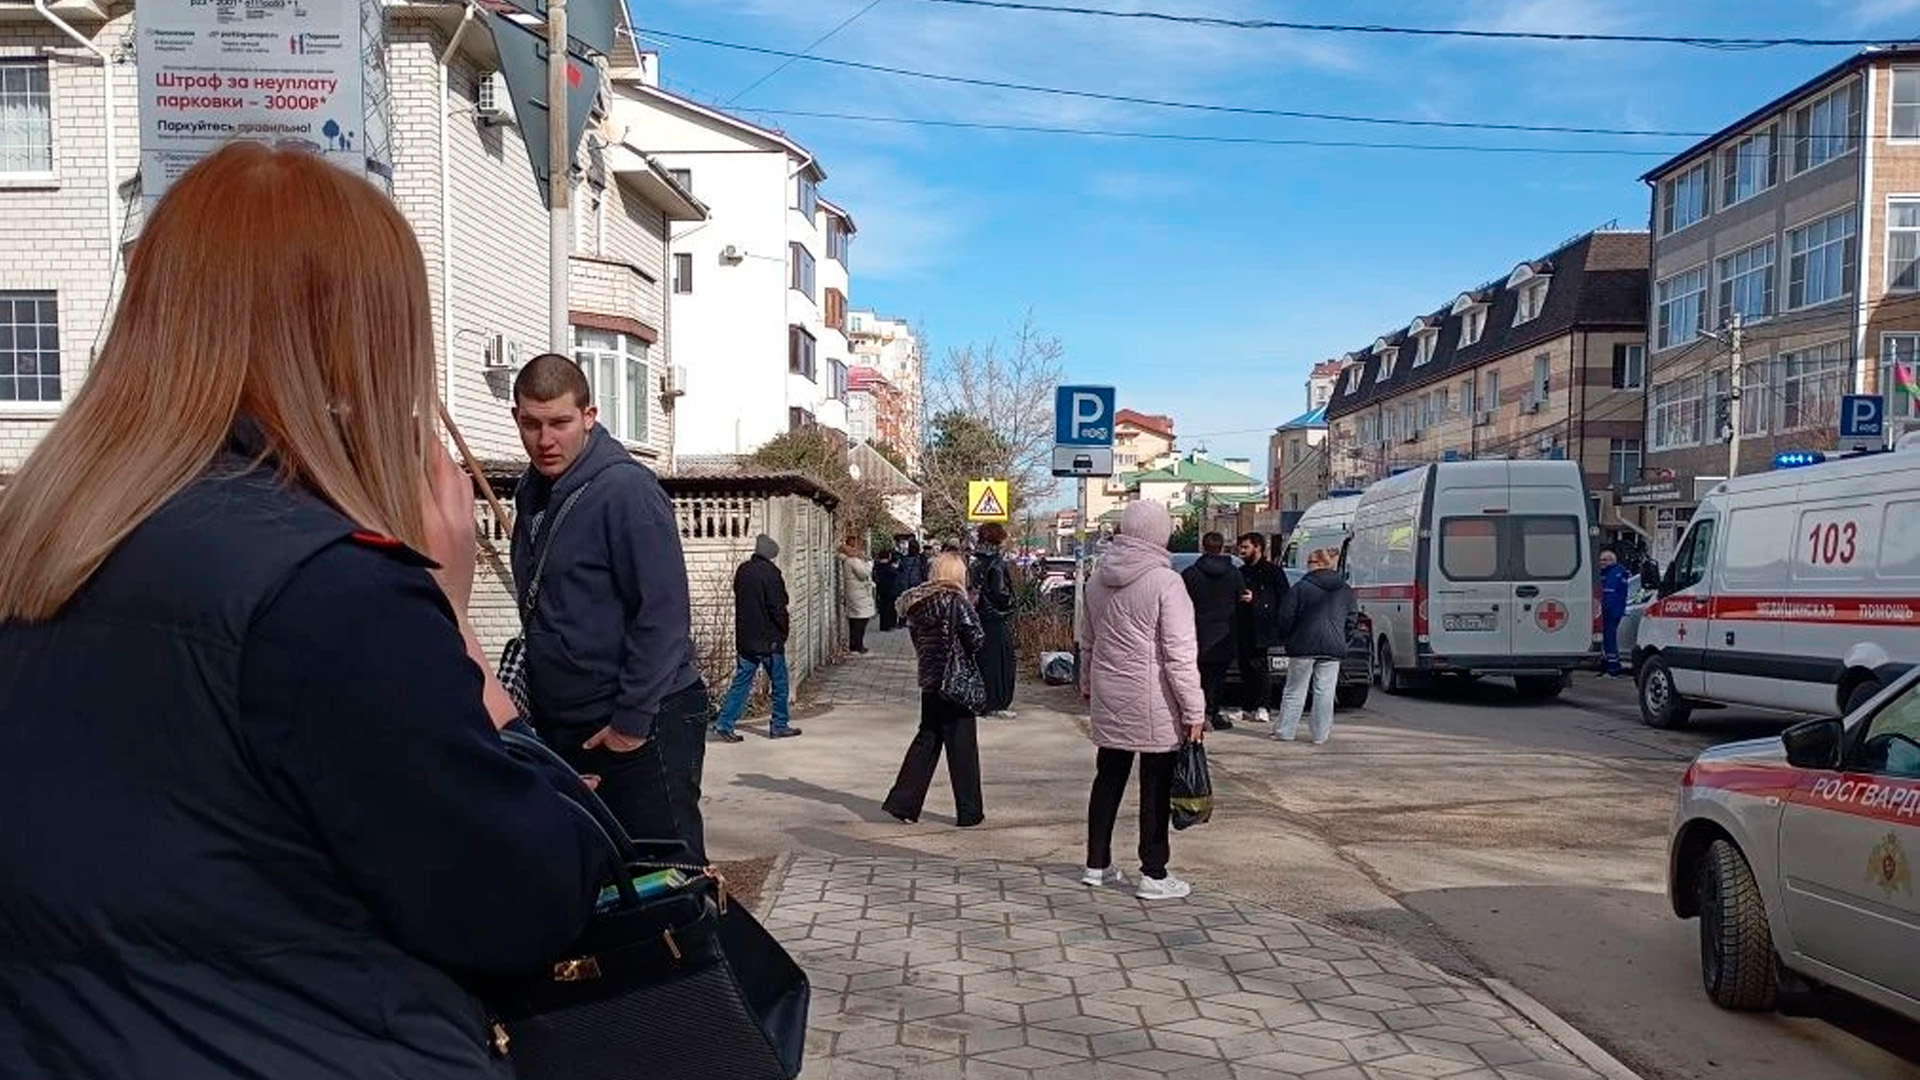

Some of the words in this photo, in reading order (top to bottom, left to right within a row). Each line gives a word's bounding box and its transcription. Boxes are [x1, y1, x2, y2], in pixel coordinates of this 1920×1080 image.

[156, 73, 222, 91] Штраф
[227, 77, 249, 89] за
[254, 77, 338, 95] неуплату
[156, 95, 243, 110] парковки
[157, 119, 235, 133] Паркуйтесь
[237, 122, 312, 134] правильно!
[1071, 391, 1105, 439] P
[1851, 399, 1877, 433] P
[1809, 521, 1857, 565] 103
[1858, 603, 1914, 620] ПОМОЩЬ
